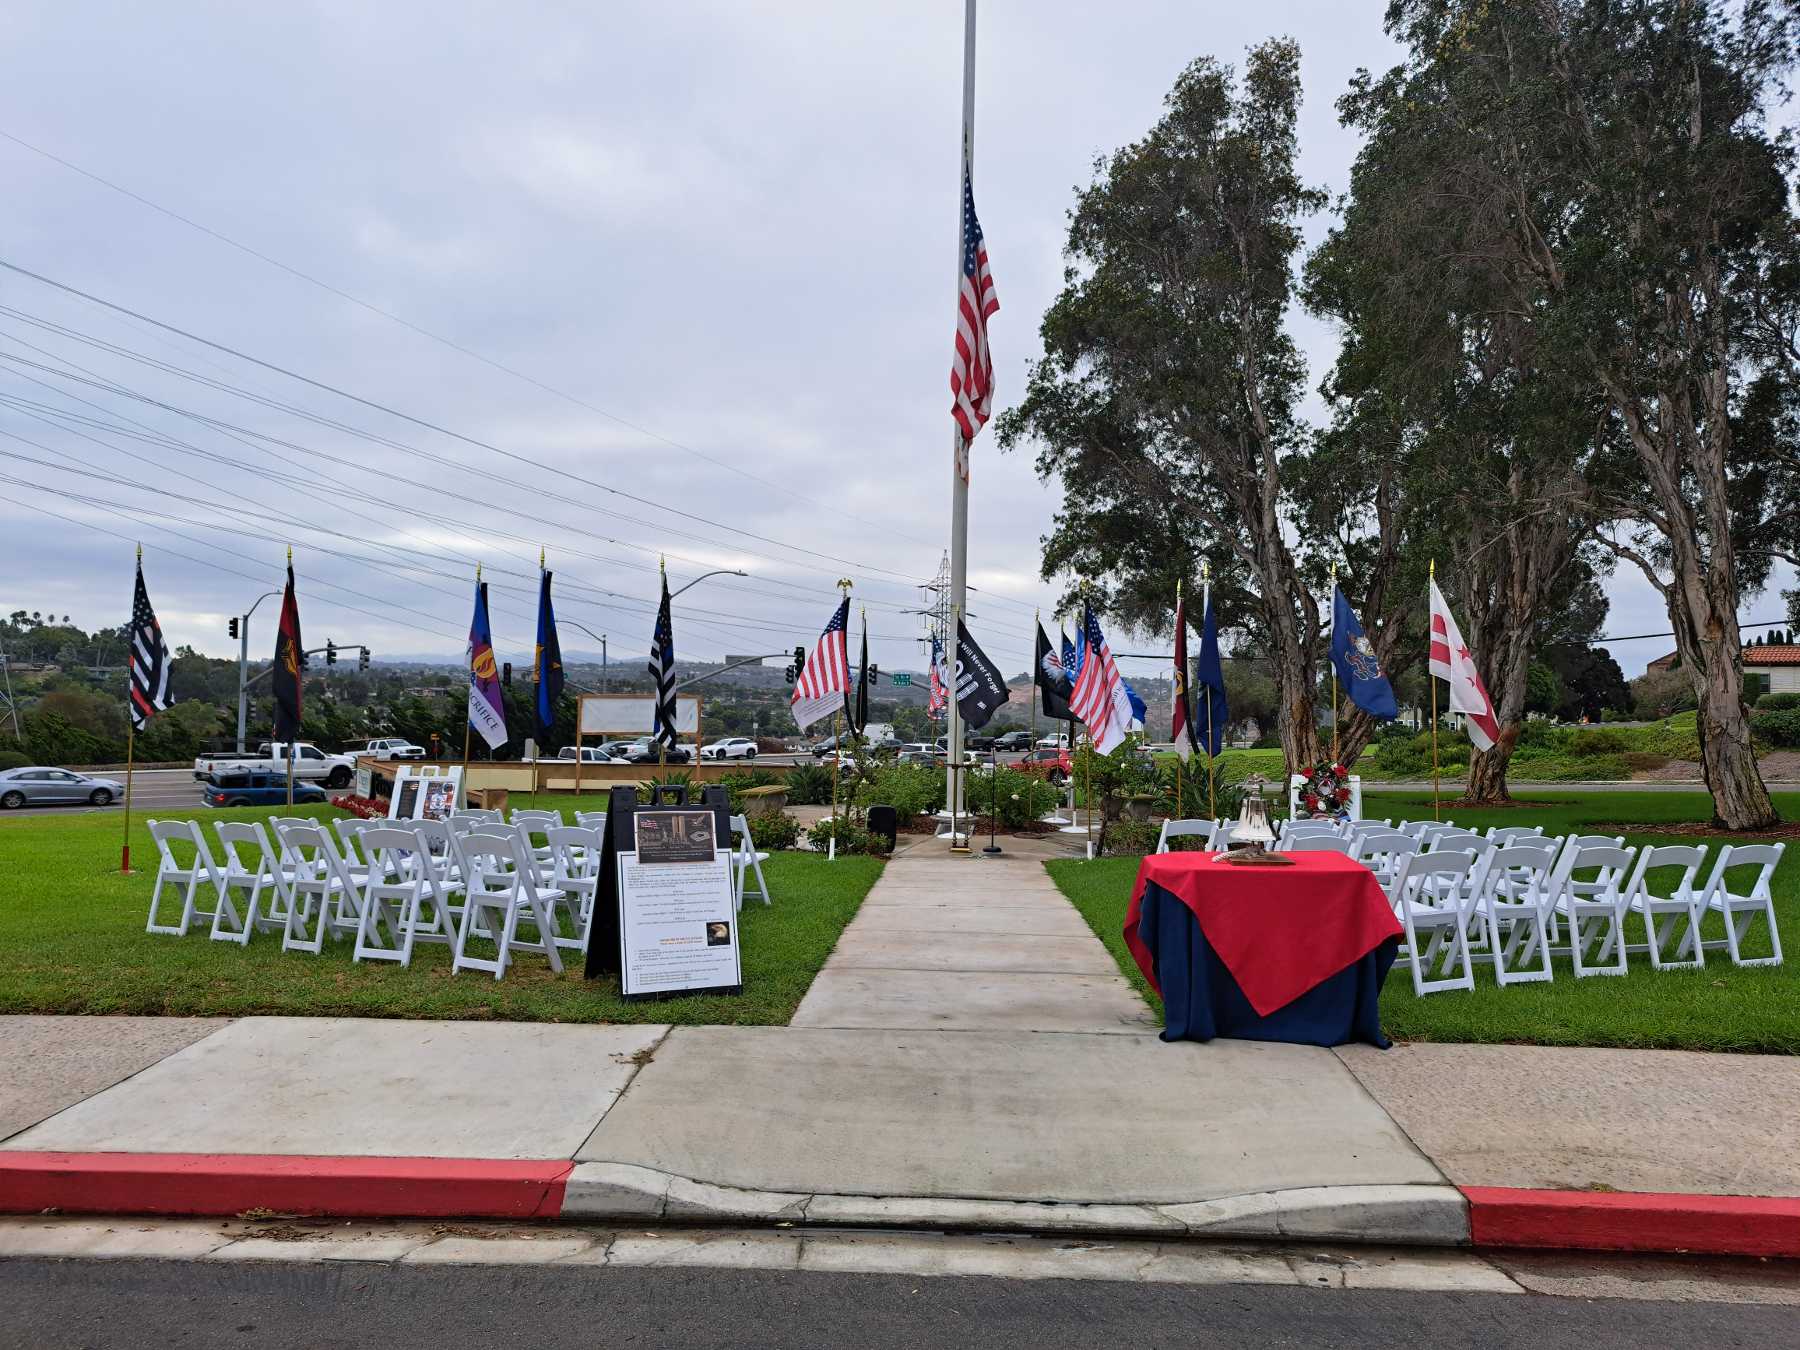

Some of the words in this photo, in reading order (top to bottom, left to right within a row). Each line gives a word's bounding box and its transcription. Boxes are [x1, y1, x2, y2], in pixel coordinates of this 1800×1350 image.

[961, 642, 973, 656] Will
[971, 654, 987, 673] Never
[985, 672, 1000, 694] Forget
[470, 693, 499, 729] CRIFICE
